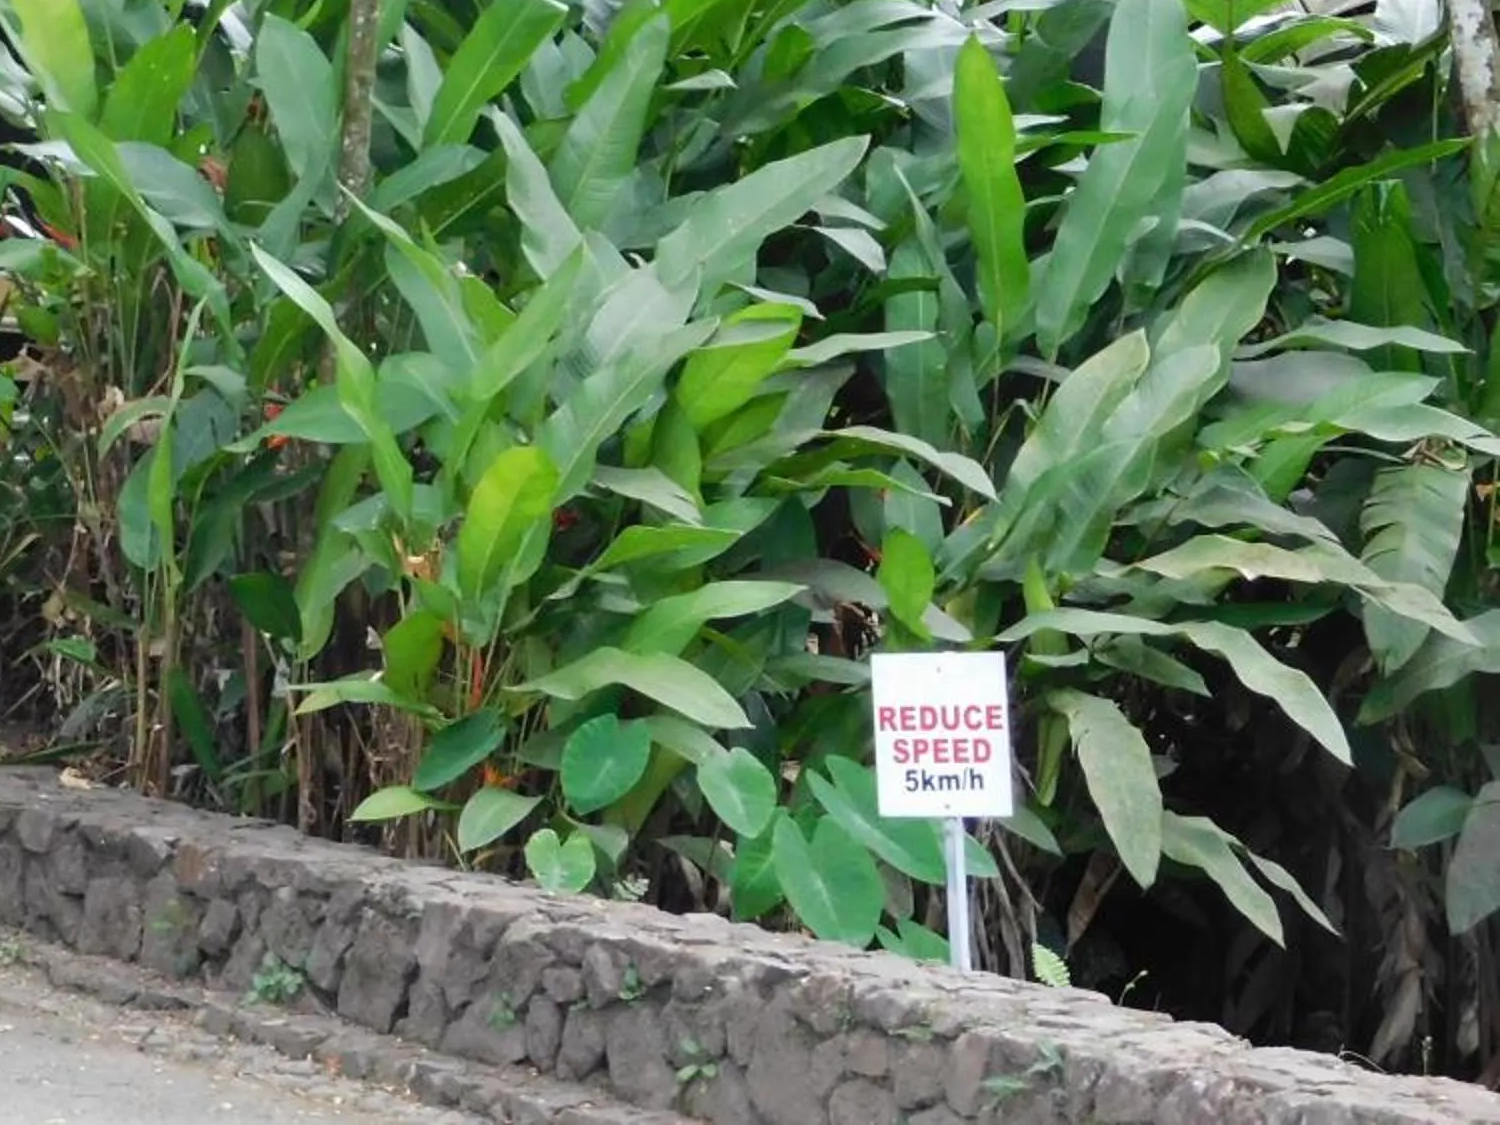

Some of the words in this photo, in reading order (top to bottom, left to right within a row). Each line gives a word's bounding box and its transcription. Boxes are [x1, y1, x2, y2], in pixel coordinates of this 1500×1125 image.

[878, 705, 1003, 731] REDUCE
[893, 738, 992, 764] SPEED
[905, 768, 985, 792] 5km/h
